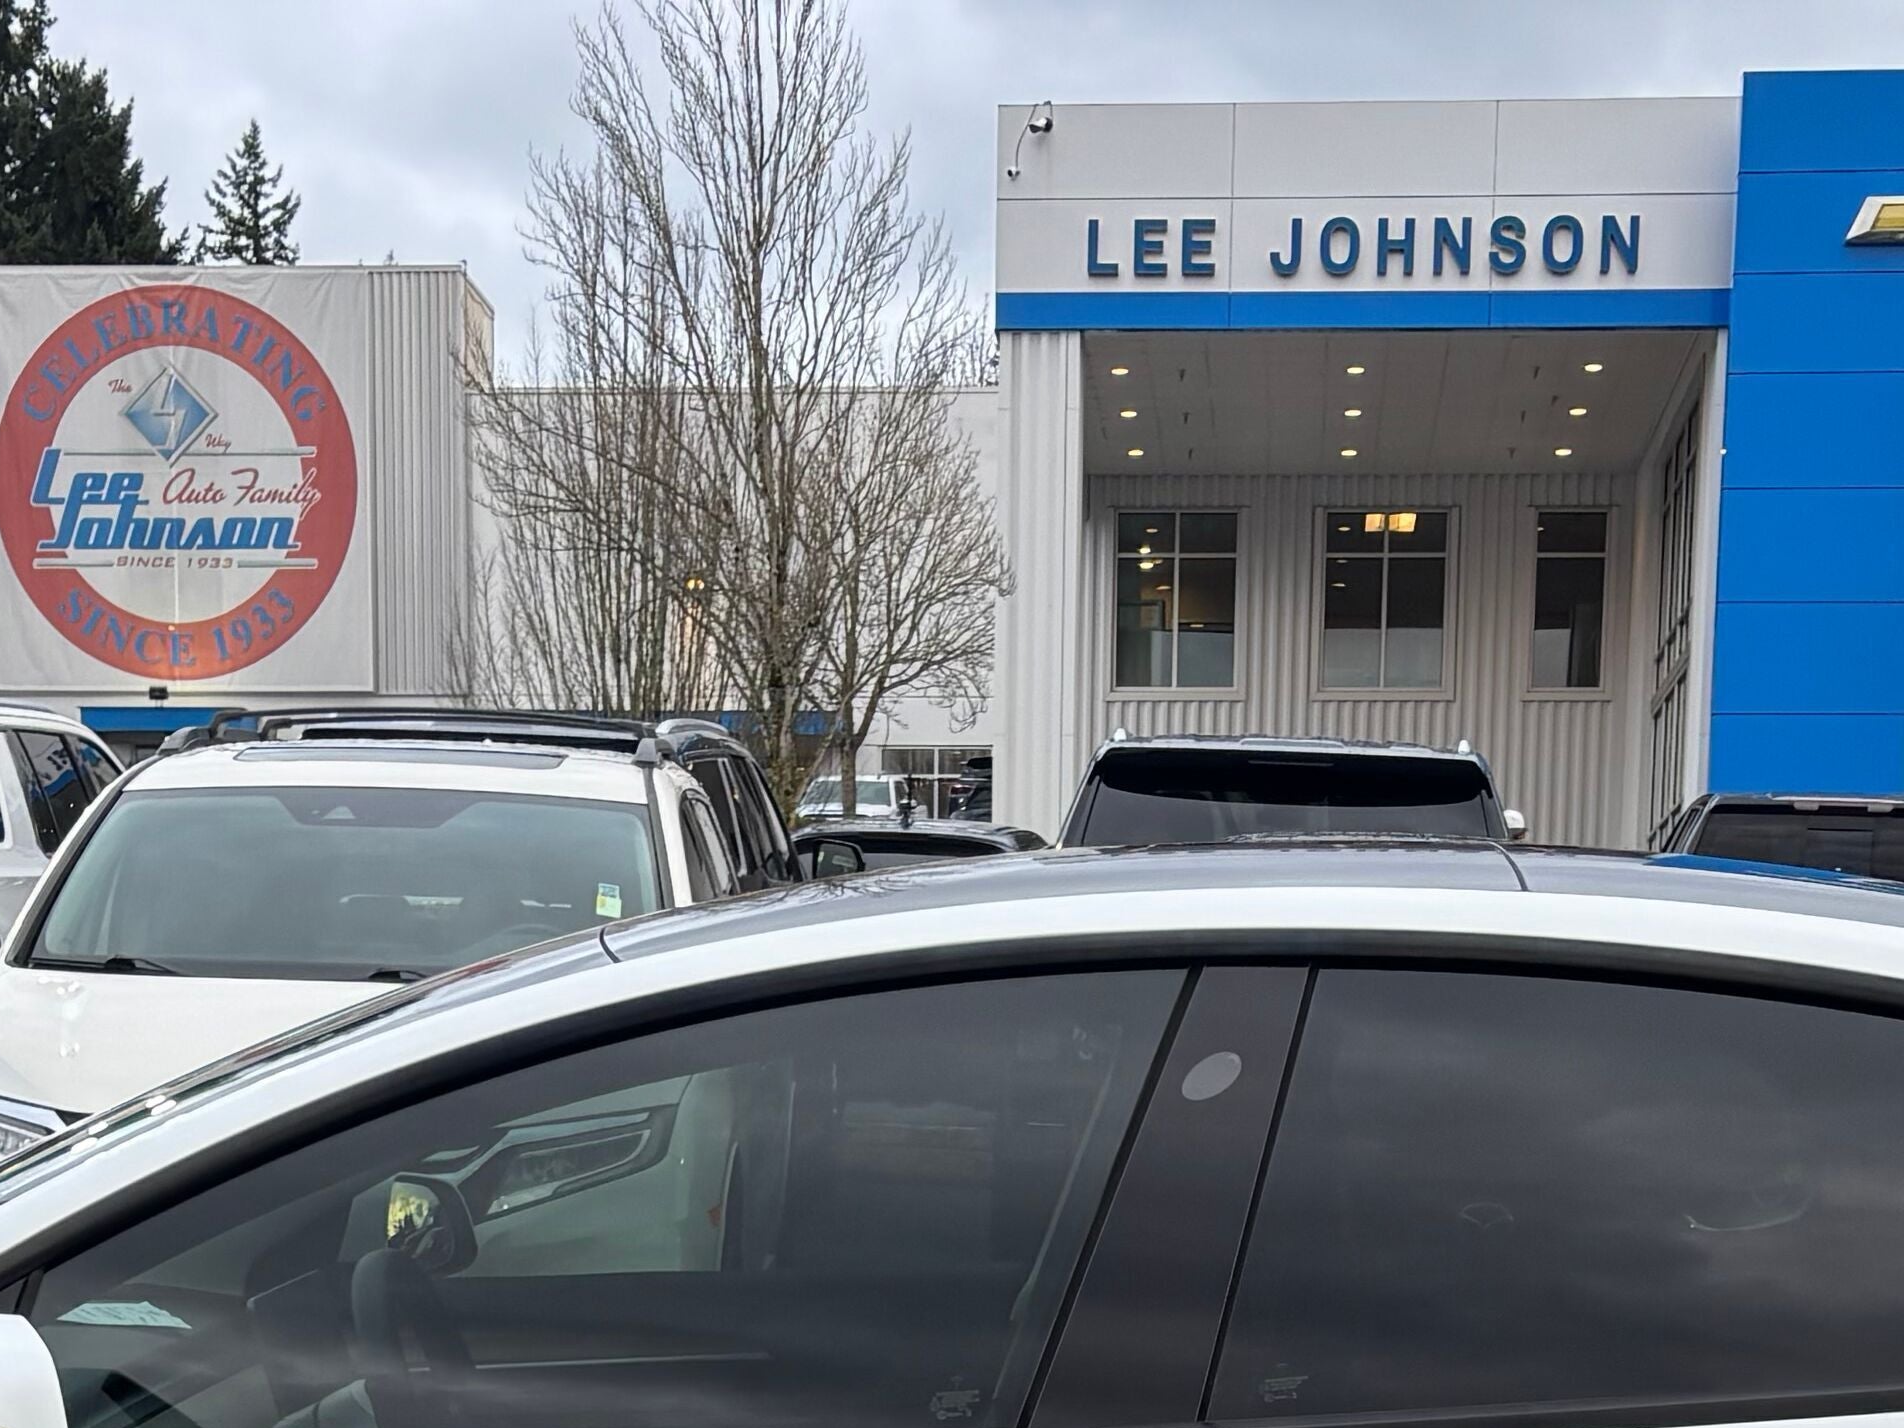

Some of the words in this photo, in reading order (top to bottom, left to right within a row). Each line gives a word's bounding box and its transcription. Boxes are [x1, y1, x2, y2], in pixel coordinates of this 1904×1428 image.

[1087, 218, 1217, 277] LEE
[1270, 214, 1641, 277] JOHNSON
[22, 298, 327, 423] CELEBRATING
[108, 379, 133, 393] The
[31, 448, 150, 505] Lee
[162, 468, 226, 505] Auto
[230, 467, 321, 521] Family
[37, 503, 301, 550] Johnson
[116, 556, 175, 568] SINCE
[186, 557, 233, 569] 1933
[57, 586, 195, 667] SINCE
[212, 586, 295, 663] 1933
